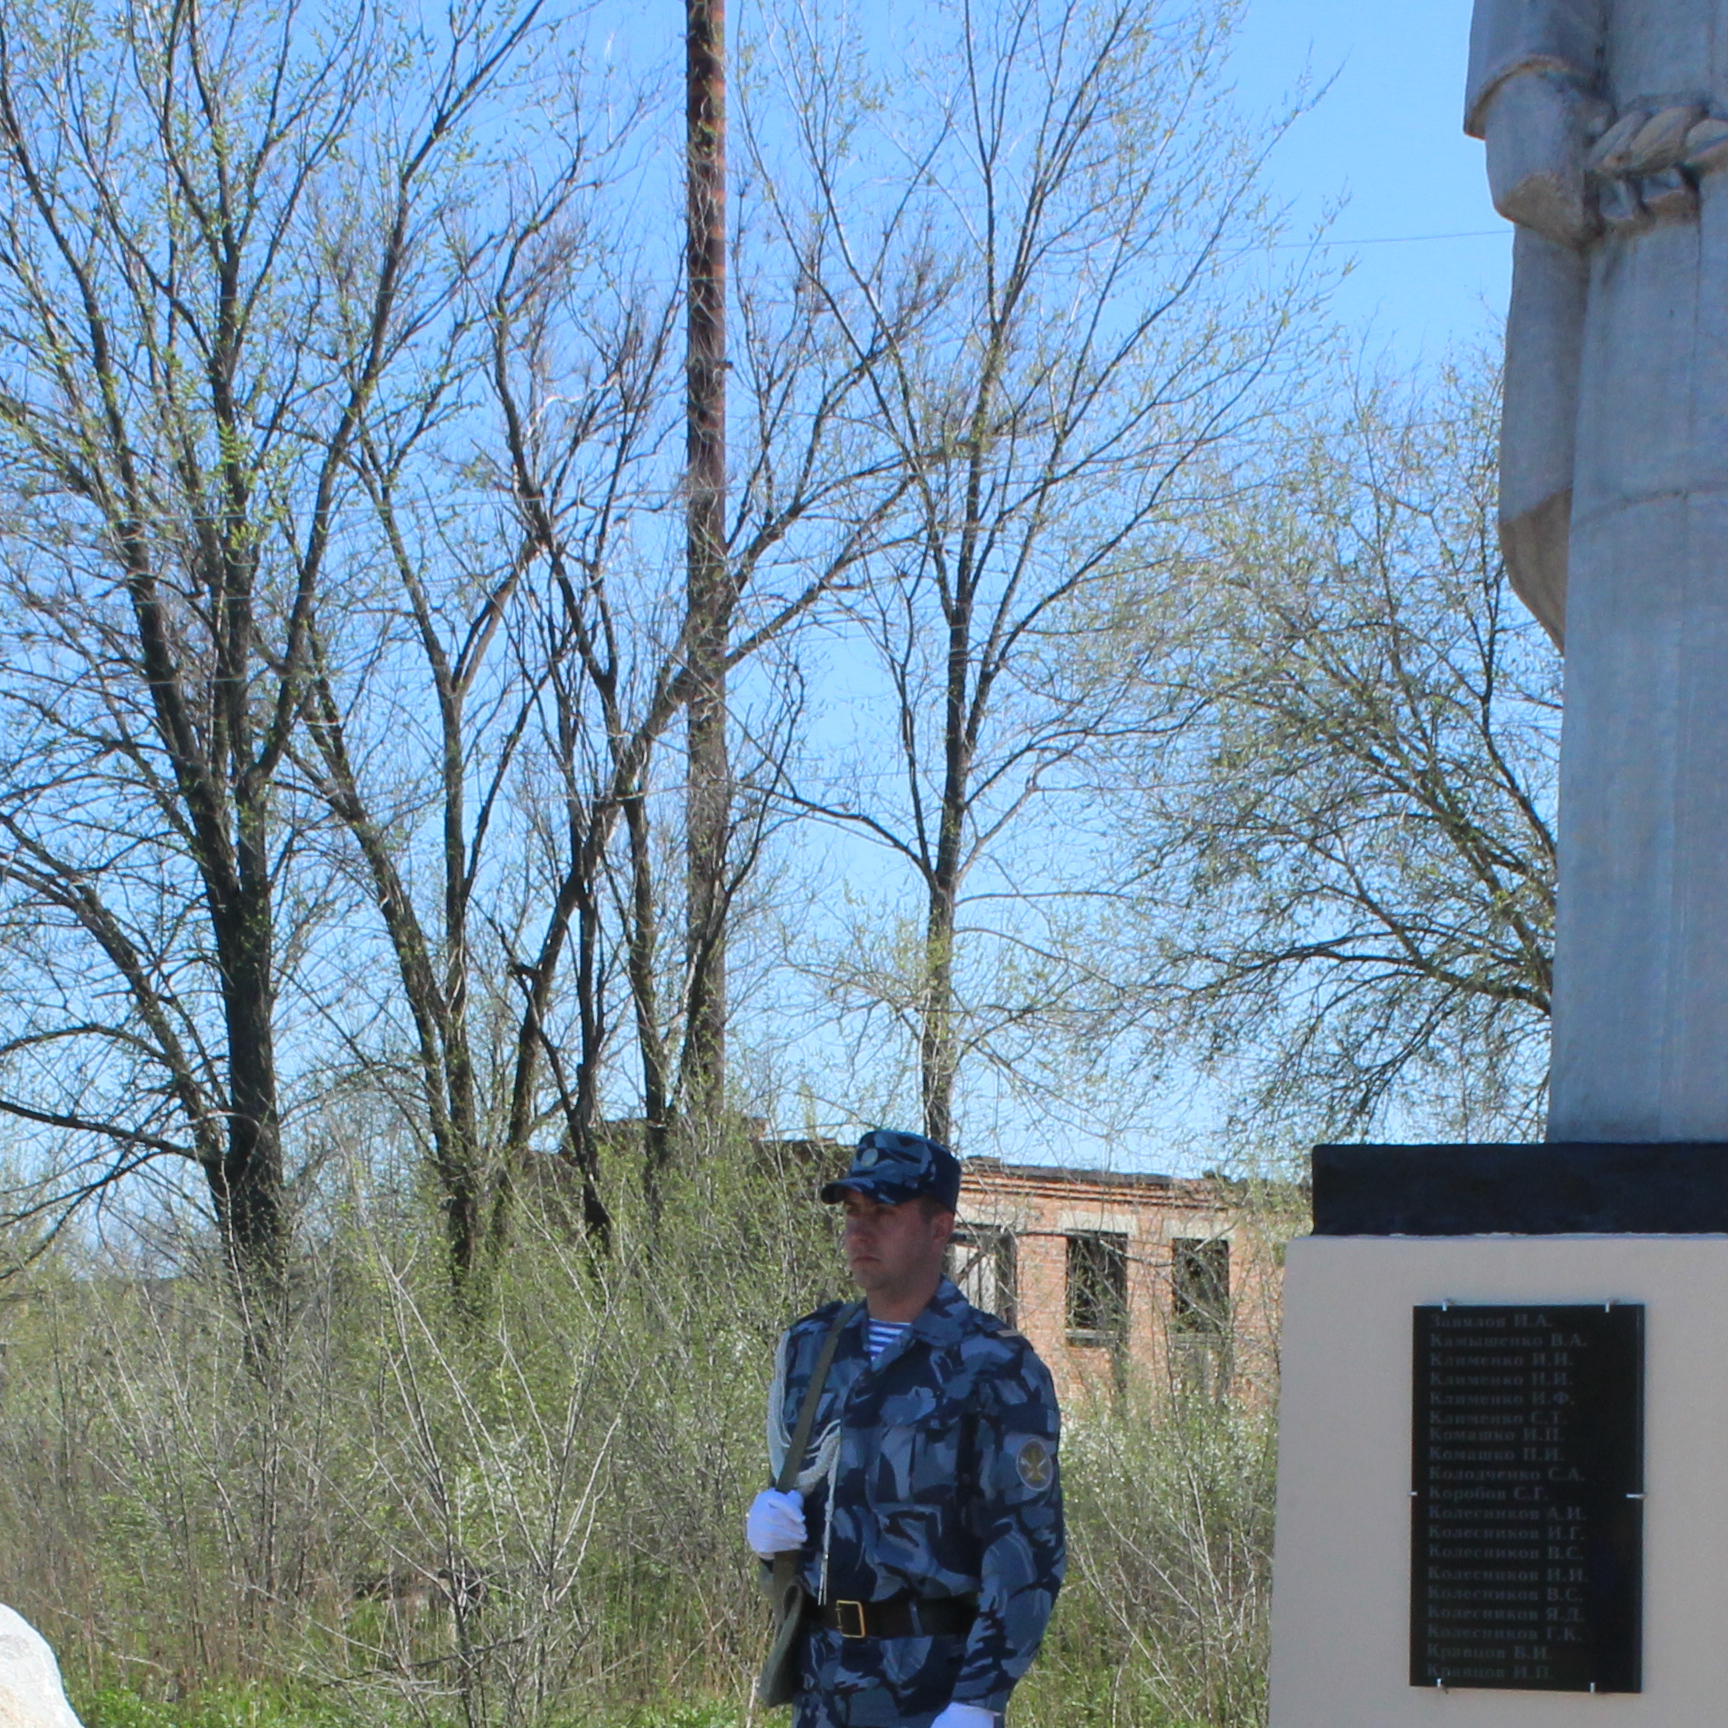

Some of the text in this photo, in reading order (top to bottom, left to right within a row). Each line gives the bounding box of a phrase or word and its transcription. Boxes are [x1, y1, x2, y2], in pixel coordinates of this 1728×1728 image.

[1430, 1333, 1543, 1347] Камышенко
[1430, 1353, 1524, 1366] Клименко
[1430, 1372, 1524, 1386] Клименко
[1430, 1391, 1524, 1405] Клименко
[1429, 1411, 1523, 1425] Клименко
[1429, 1427, 1516, 1441] Комашко
[1429, 1447, 1516, 1461] Комашко
[1429, 1466, 1541, 1480] Колодченко
[1429, 1486, 1506, 1501] Коробов
[1429, 1506, 1540, 1520] Колесников
[1428, 1525, 1540, 1539] Колесников
[1428, 1545, 1540, 1559] Колесников
[1428, 1566, 1539, 1581] Колесников
[1428, 1586, 1539, 1600] Колесников
[1428, 1605, 1539, 1620] Колесников
[1427, 1625, 1538, 1639] Колесников
[1427, 1644, 1506, 1659] Кравцов
